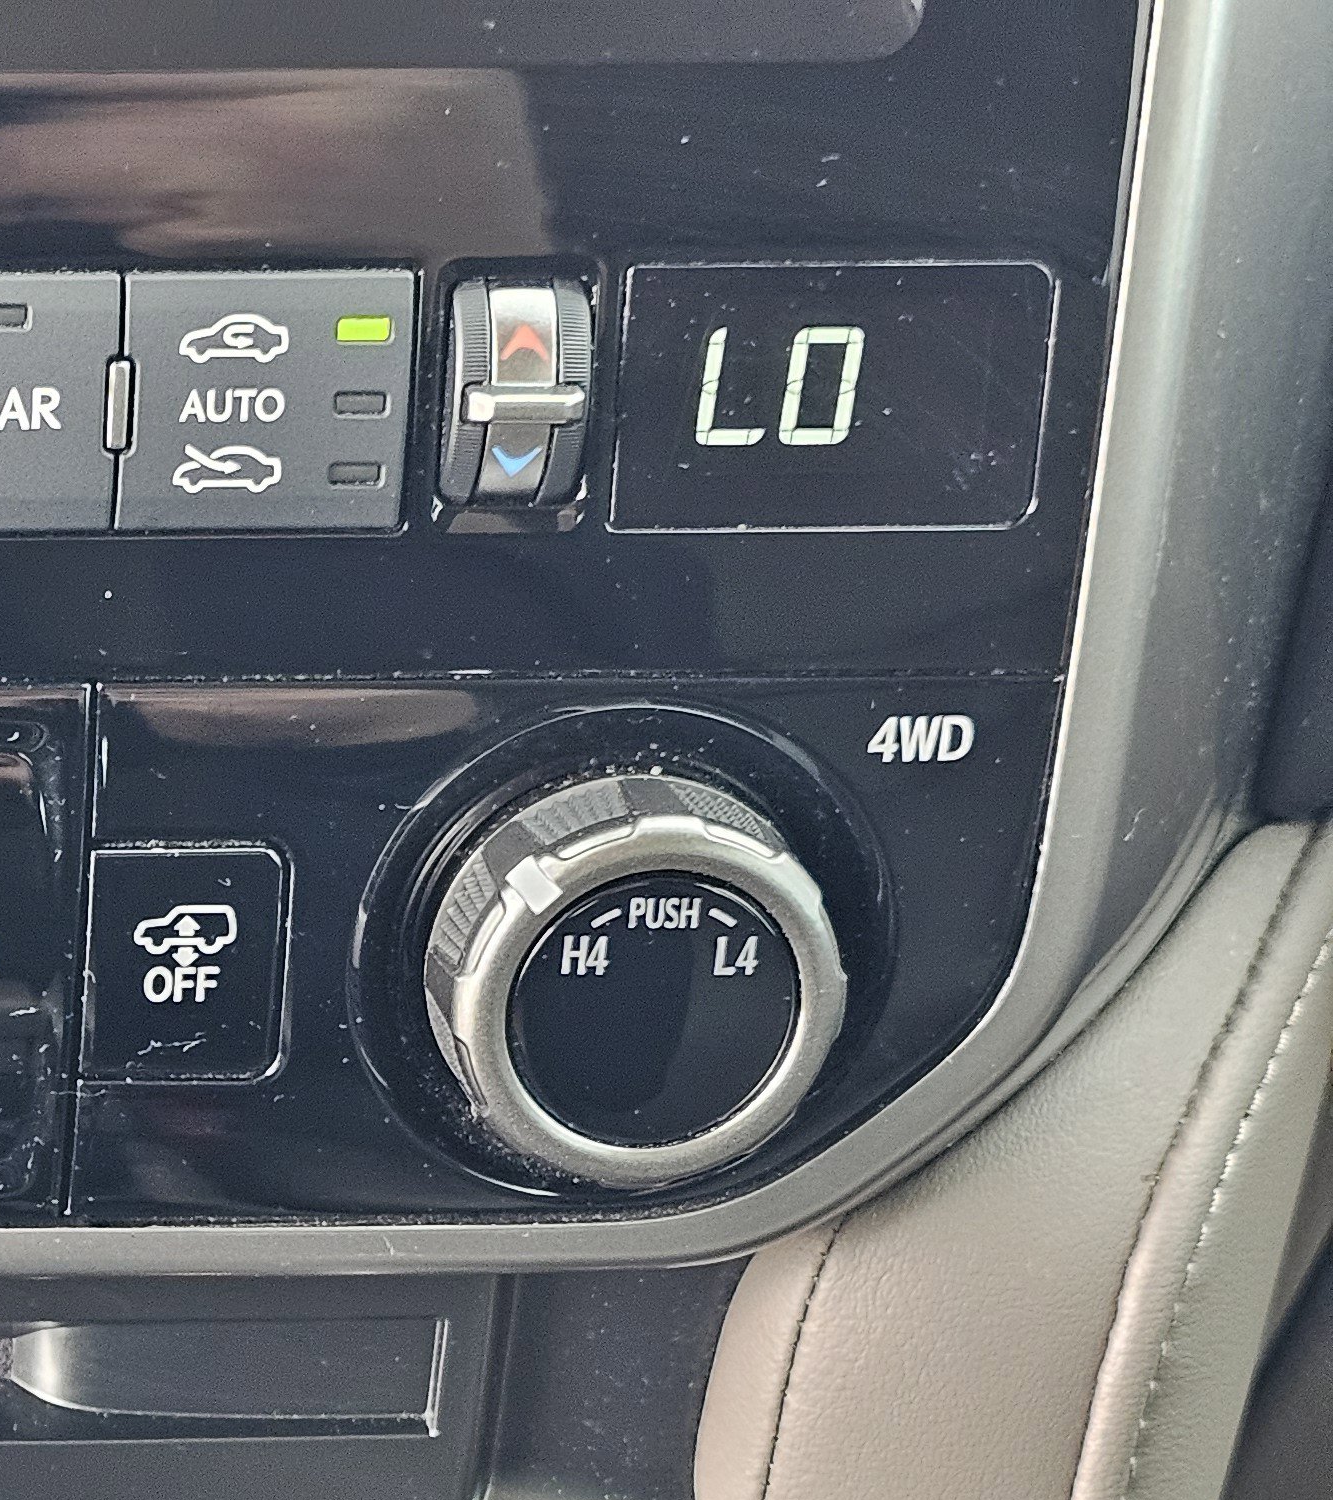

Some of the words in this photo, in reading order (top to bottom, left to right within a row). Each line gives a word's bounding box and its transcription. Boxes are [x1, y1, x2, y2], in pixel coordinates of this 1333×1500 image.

[178, 388, 286, 423] AUTO
[867, 714, 975, 763] 4WD
[627, 897, 702, 930] PUSH
[560, 934, 610, 976] H4
[713, 935, 759, 976] L4
[143, 963, 221, 1003] OFF
